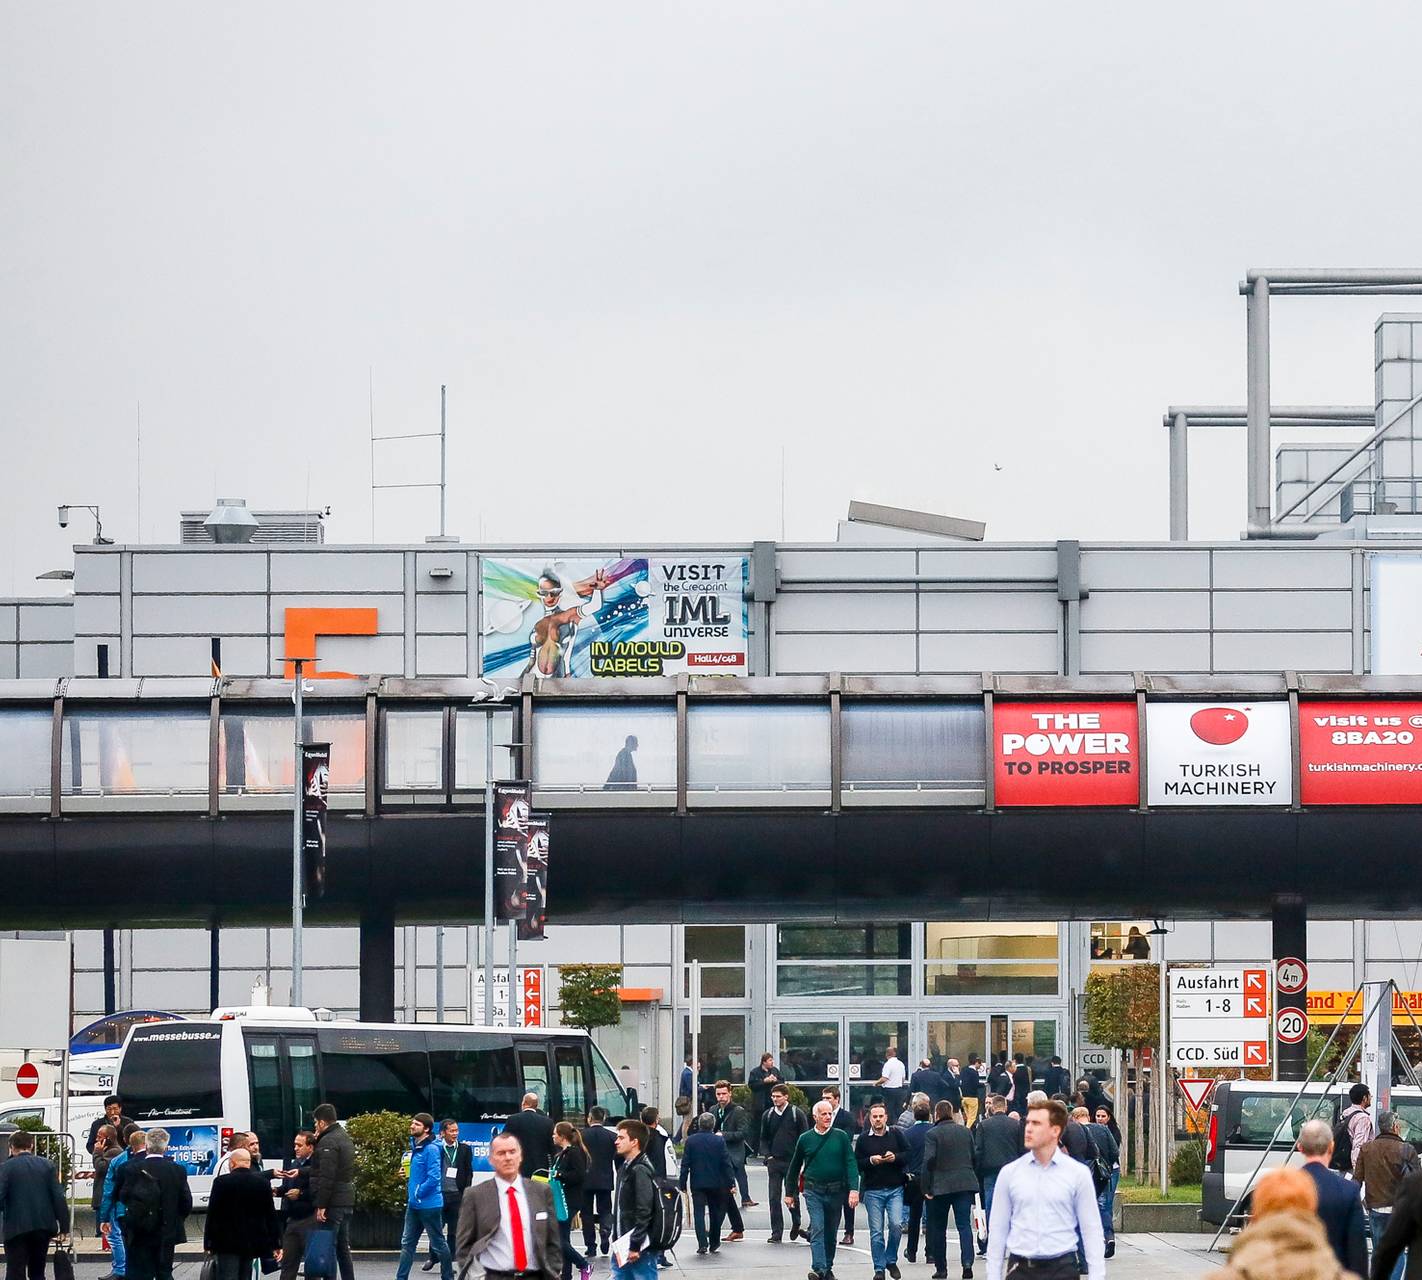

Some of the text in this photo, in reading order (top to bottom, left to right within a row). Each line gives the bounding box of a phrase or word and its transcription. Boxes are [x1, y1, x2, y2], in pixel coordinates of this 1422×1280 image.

[662, 565, 726, 580] VISIT
[664, 582, 728, 594] the Creaprint
[664, 593, 731, 626] IML
[591, 641, 682, 656] IN MOULD
[591, 658, 660, 672] LABELS
[1031, 713, 1100, 730] THE
[1313, 714, 1371, 727] visit
[1375, 716, 1403, 727] us
[1002, 733, 1130, 756] POWER
[1331, 730, 1414, 746] 8BA20
[1004, 760, 1131, 775] TO PROSPER
[1180, 764, 1261, 778] TURKISH
[1164, 781, 1277, 796] MACHINERY
[1177, 976, 1239, 989] Ausfahrt
[1282, 1018, 1302, 1033] 20
[133, 1031, 221, 1042] www.messebusse.de
[1083, 1054, 1107, 1064] CCD.
[1177, 1046, 1239, 1060] CCD. Süd
